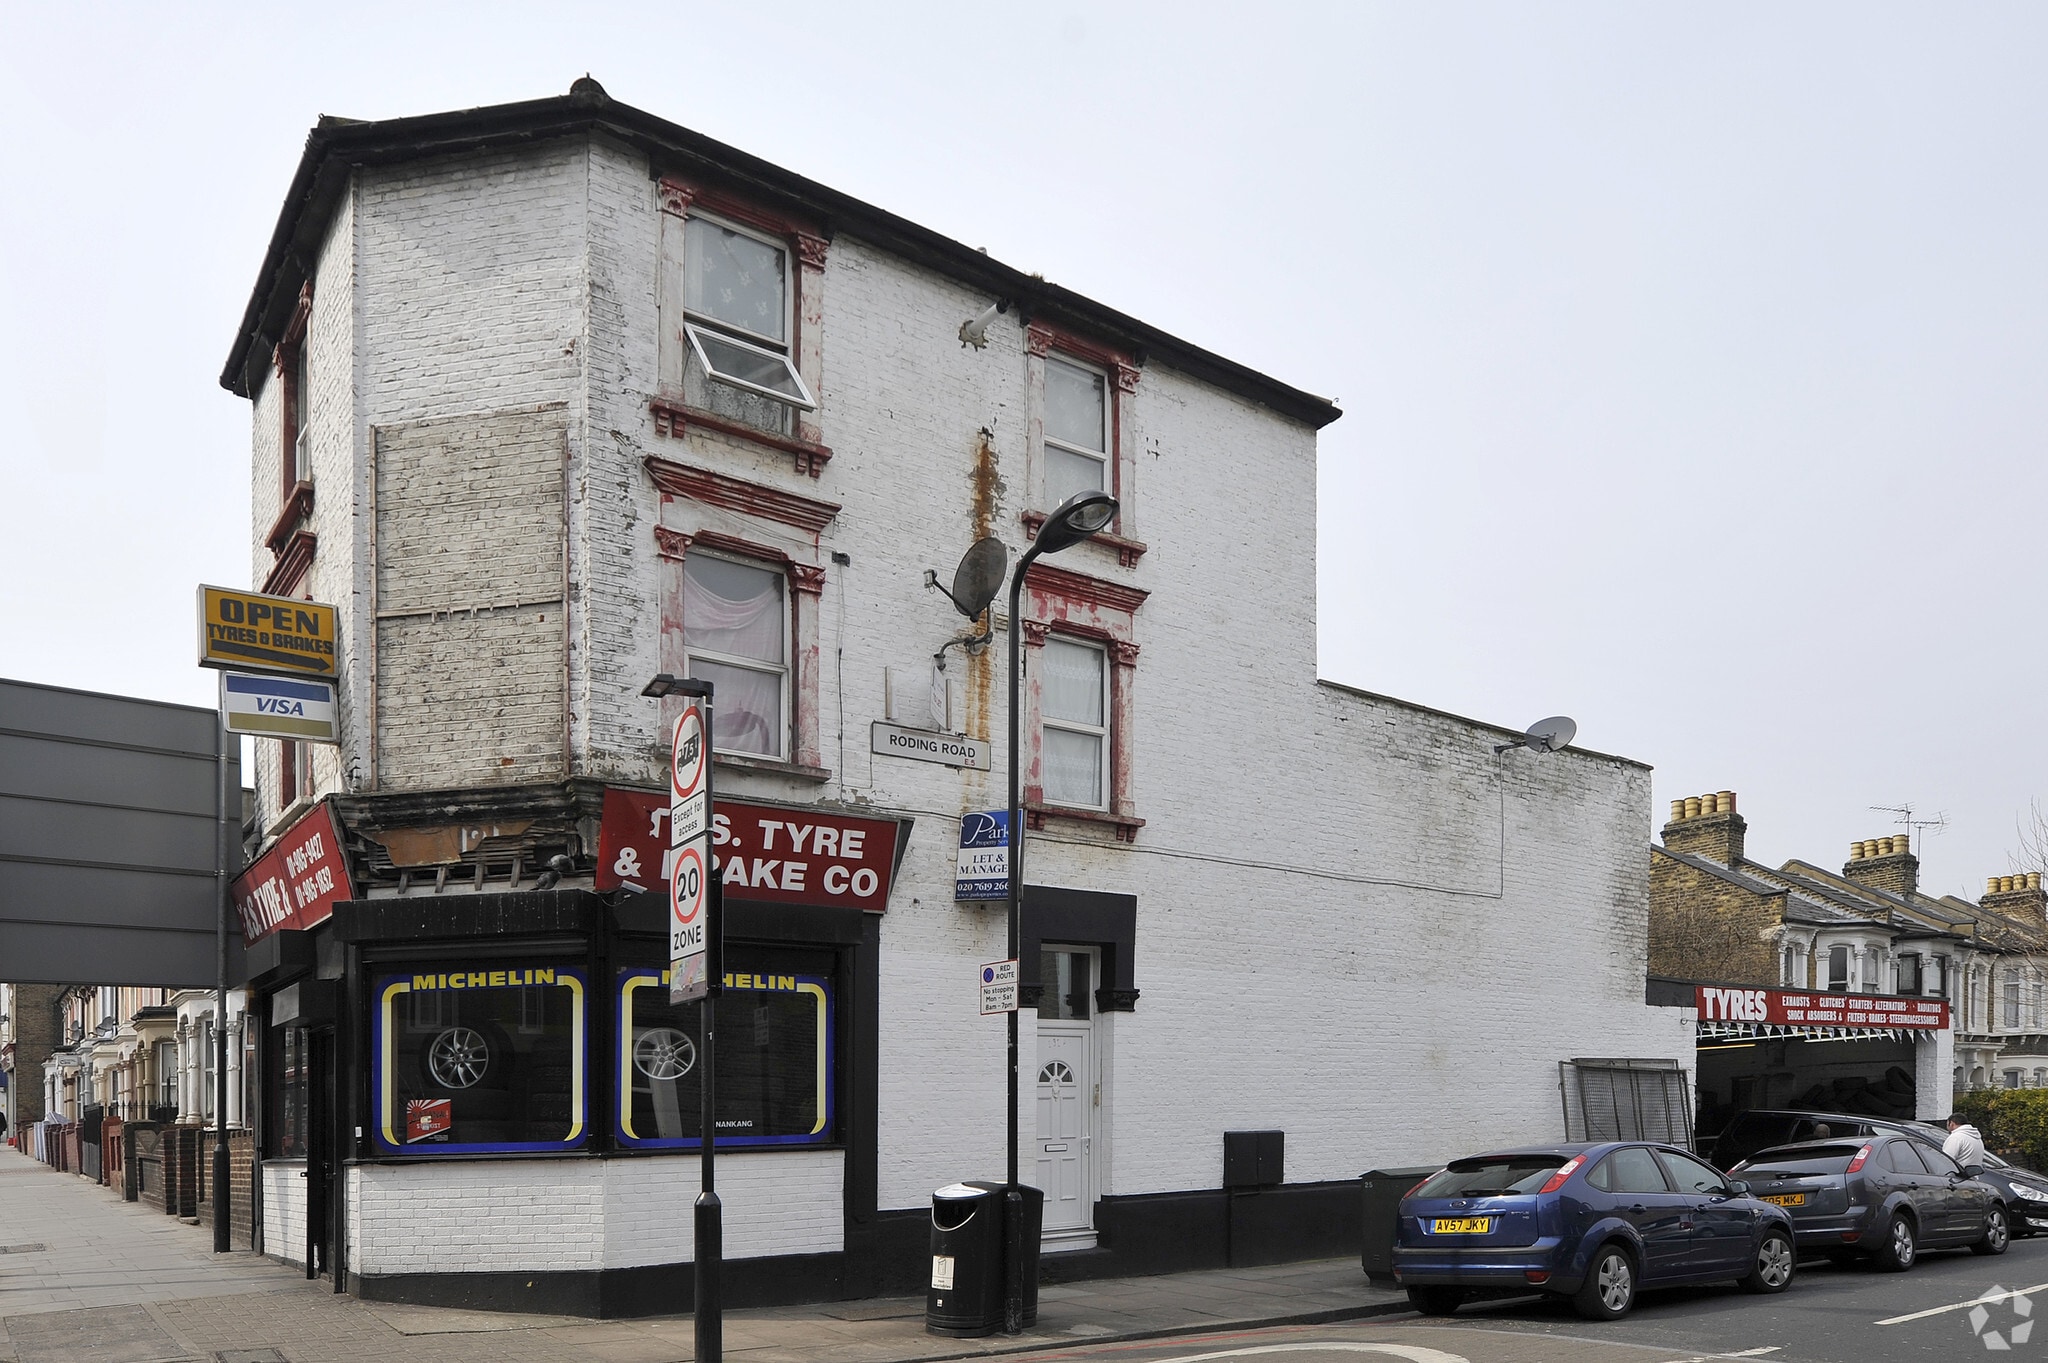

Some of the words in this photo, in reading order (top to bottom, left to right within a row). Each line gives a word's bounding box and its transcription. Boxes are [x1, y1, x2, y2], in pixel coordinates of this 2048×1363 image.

[220, 598, 319, 636] OPEN
[207, 623, 257, 644] TYRES
[260, 631, 270, 645] &
[273, 632, 334, 655] BRAKES
[256, 697, 304, 716] VISA
[889, 734, 938, 753] RODING
[942, 743, 976, 758] ROAD
[673, 805, 693, 825] Except
[694, 800, 703, 814] for
[678, 820, 698, 837] access
[758, 819, 866, 860] TYRE
[973, 854, 994, 864] LET
[996, 853, 1004, 862] &
[613, 846, 642, 878] &
[823, 865, 879, 898] CO
[959, 864, 1008, 875] MANAGE
[677, 867, 698, 903] 20
[957, 883, 973, 891] 020
[974, 882, 992, 891] 7619
[994, 881, 1008, 890] 266
[253, 876, 286, 930] TYRE
[279, 879, 293, 916] &
[674, 925, 702, 951] ZONE
[413, 968, 554, 990] MICHELIN
[996, 971, 1015, 980] ROUTE
[992, 986, 1014, 994] stopping
[1703, 988, 1768, 1021] TYRES
[1782, 995, 1810, 1007] EXHAUSTS
[1917, 1003, 1941, 1013] RADIATORS
[1787, 1010, 1804, 1020] SHOCK
[1807, 1010, 1837, 1021] ABSORBERS
[715, 1120, 753, 1128] NANKANG
[1783, 1195, 1803, 1204] MKJ
[1437, 1219, 1463, 1230] AV57
[1465, 1219, 1486, 1230] JKY
